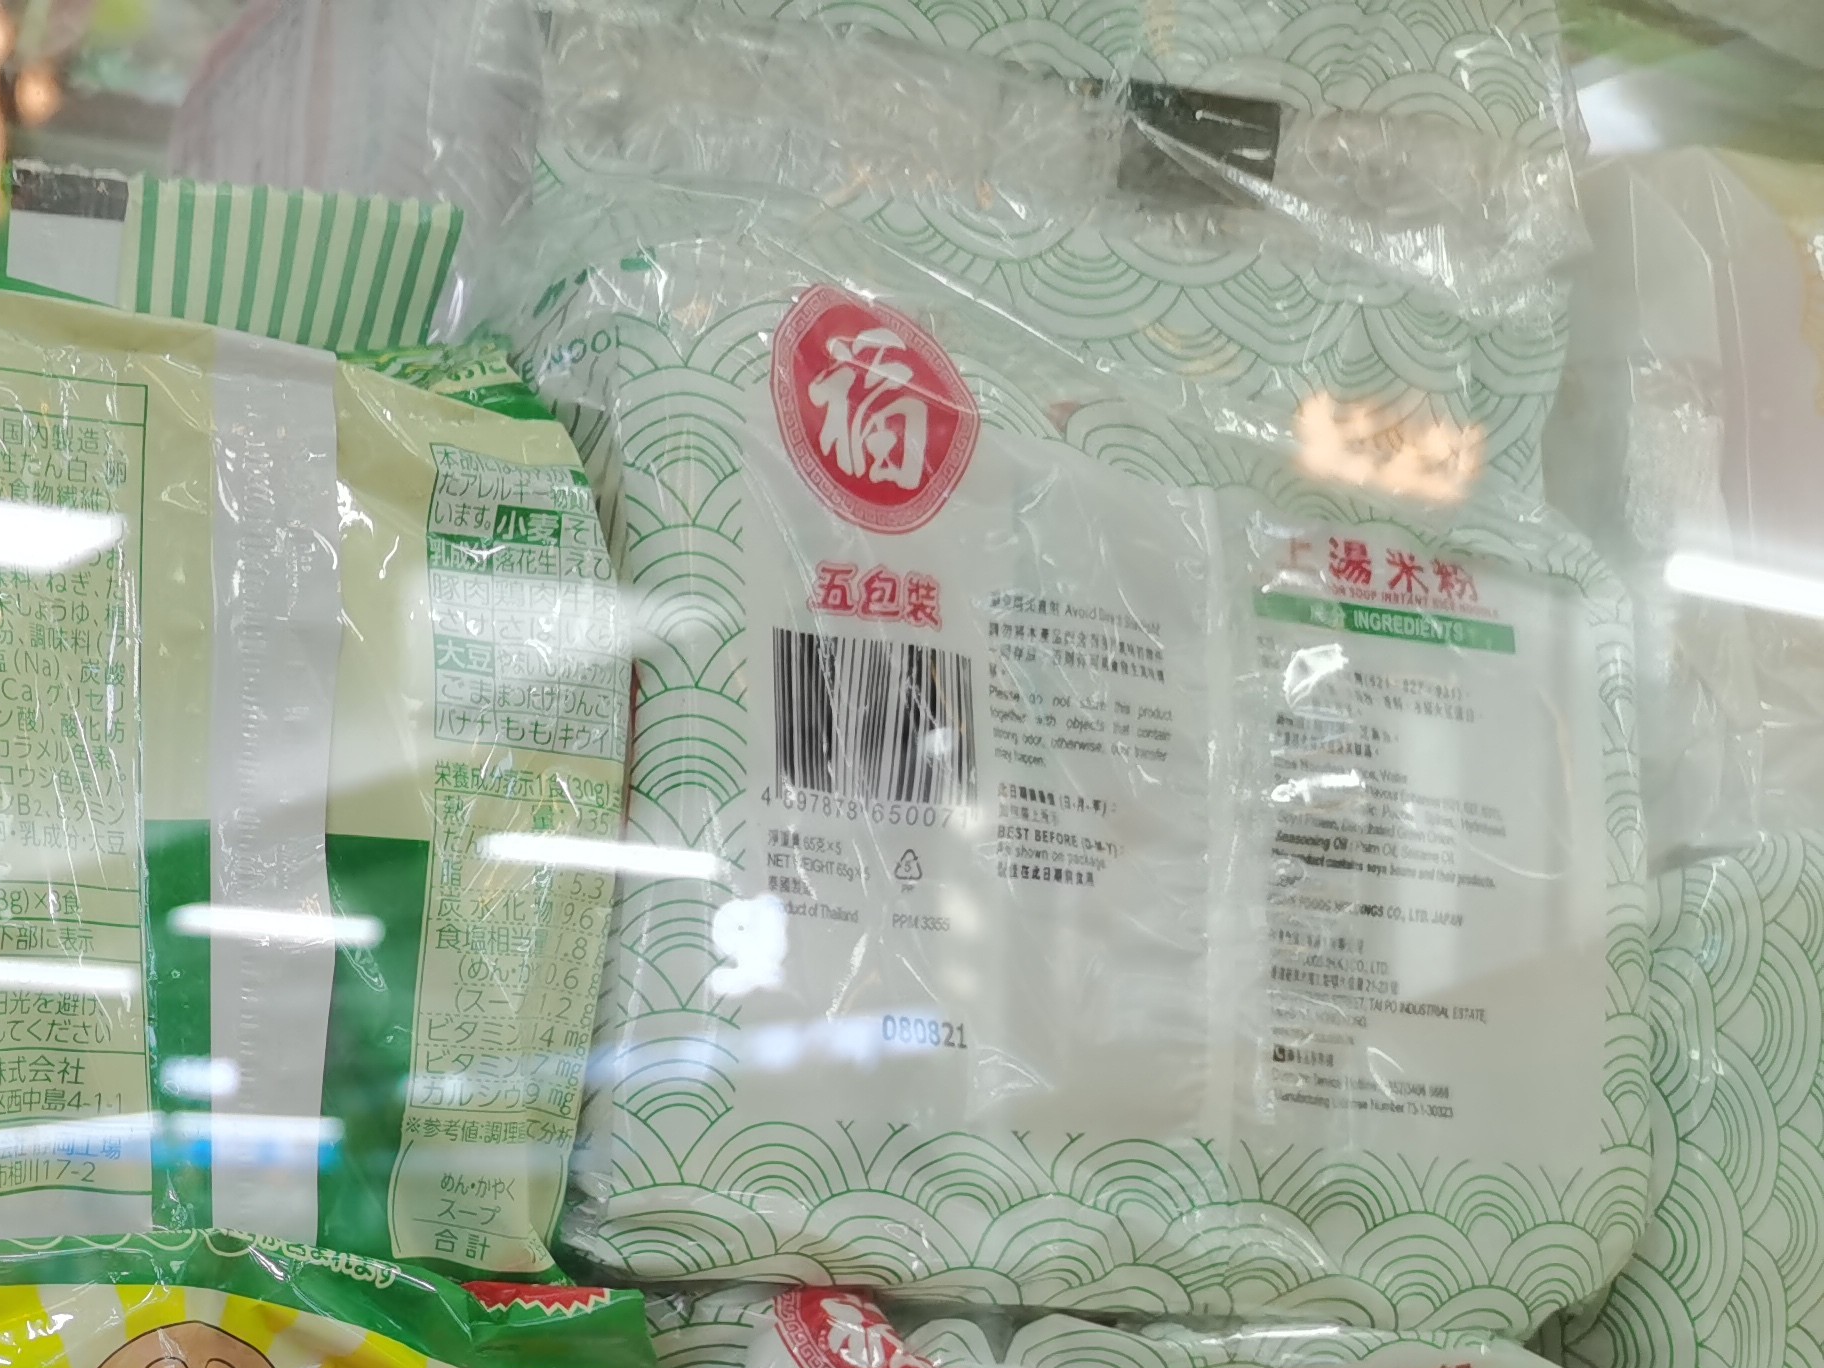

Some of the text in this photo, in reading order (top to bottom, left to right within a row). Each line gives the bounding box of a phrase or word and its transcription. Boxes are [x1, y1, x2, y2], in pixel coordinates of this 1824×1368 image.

[808, 328, 928, 491] 福
[497, 507, 560, 544] 小麦
[494, 550, 558, 578] 落花生
[1352, 608, 1466, 643] INGREDIENTS
[437, 640, 494, 671] 大豆
[499, 715, 554, 747] もも
[881, 1014, 969, 1050] 080821
[436, 1203, 502, 1226] スープ
